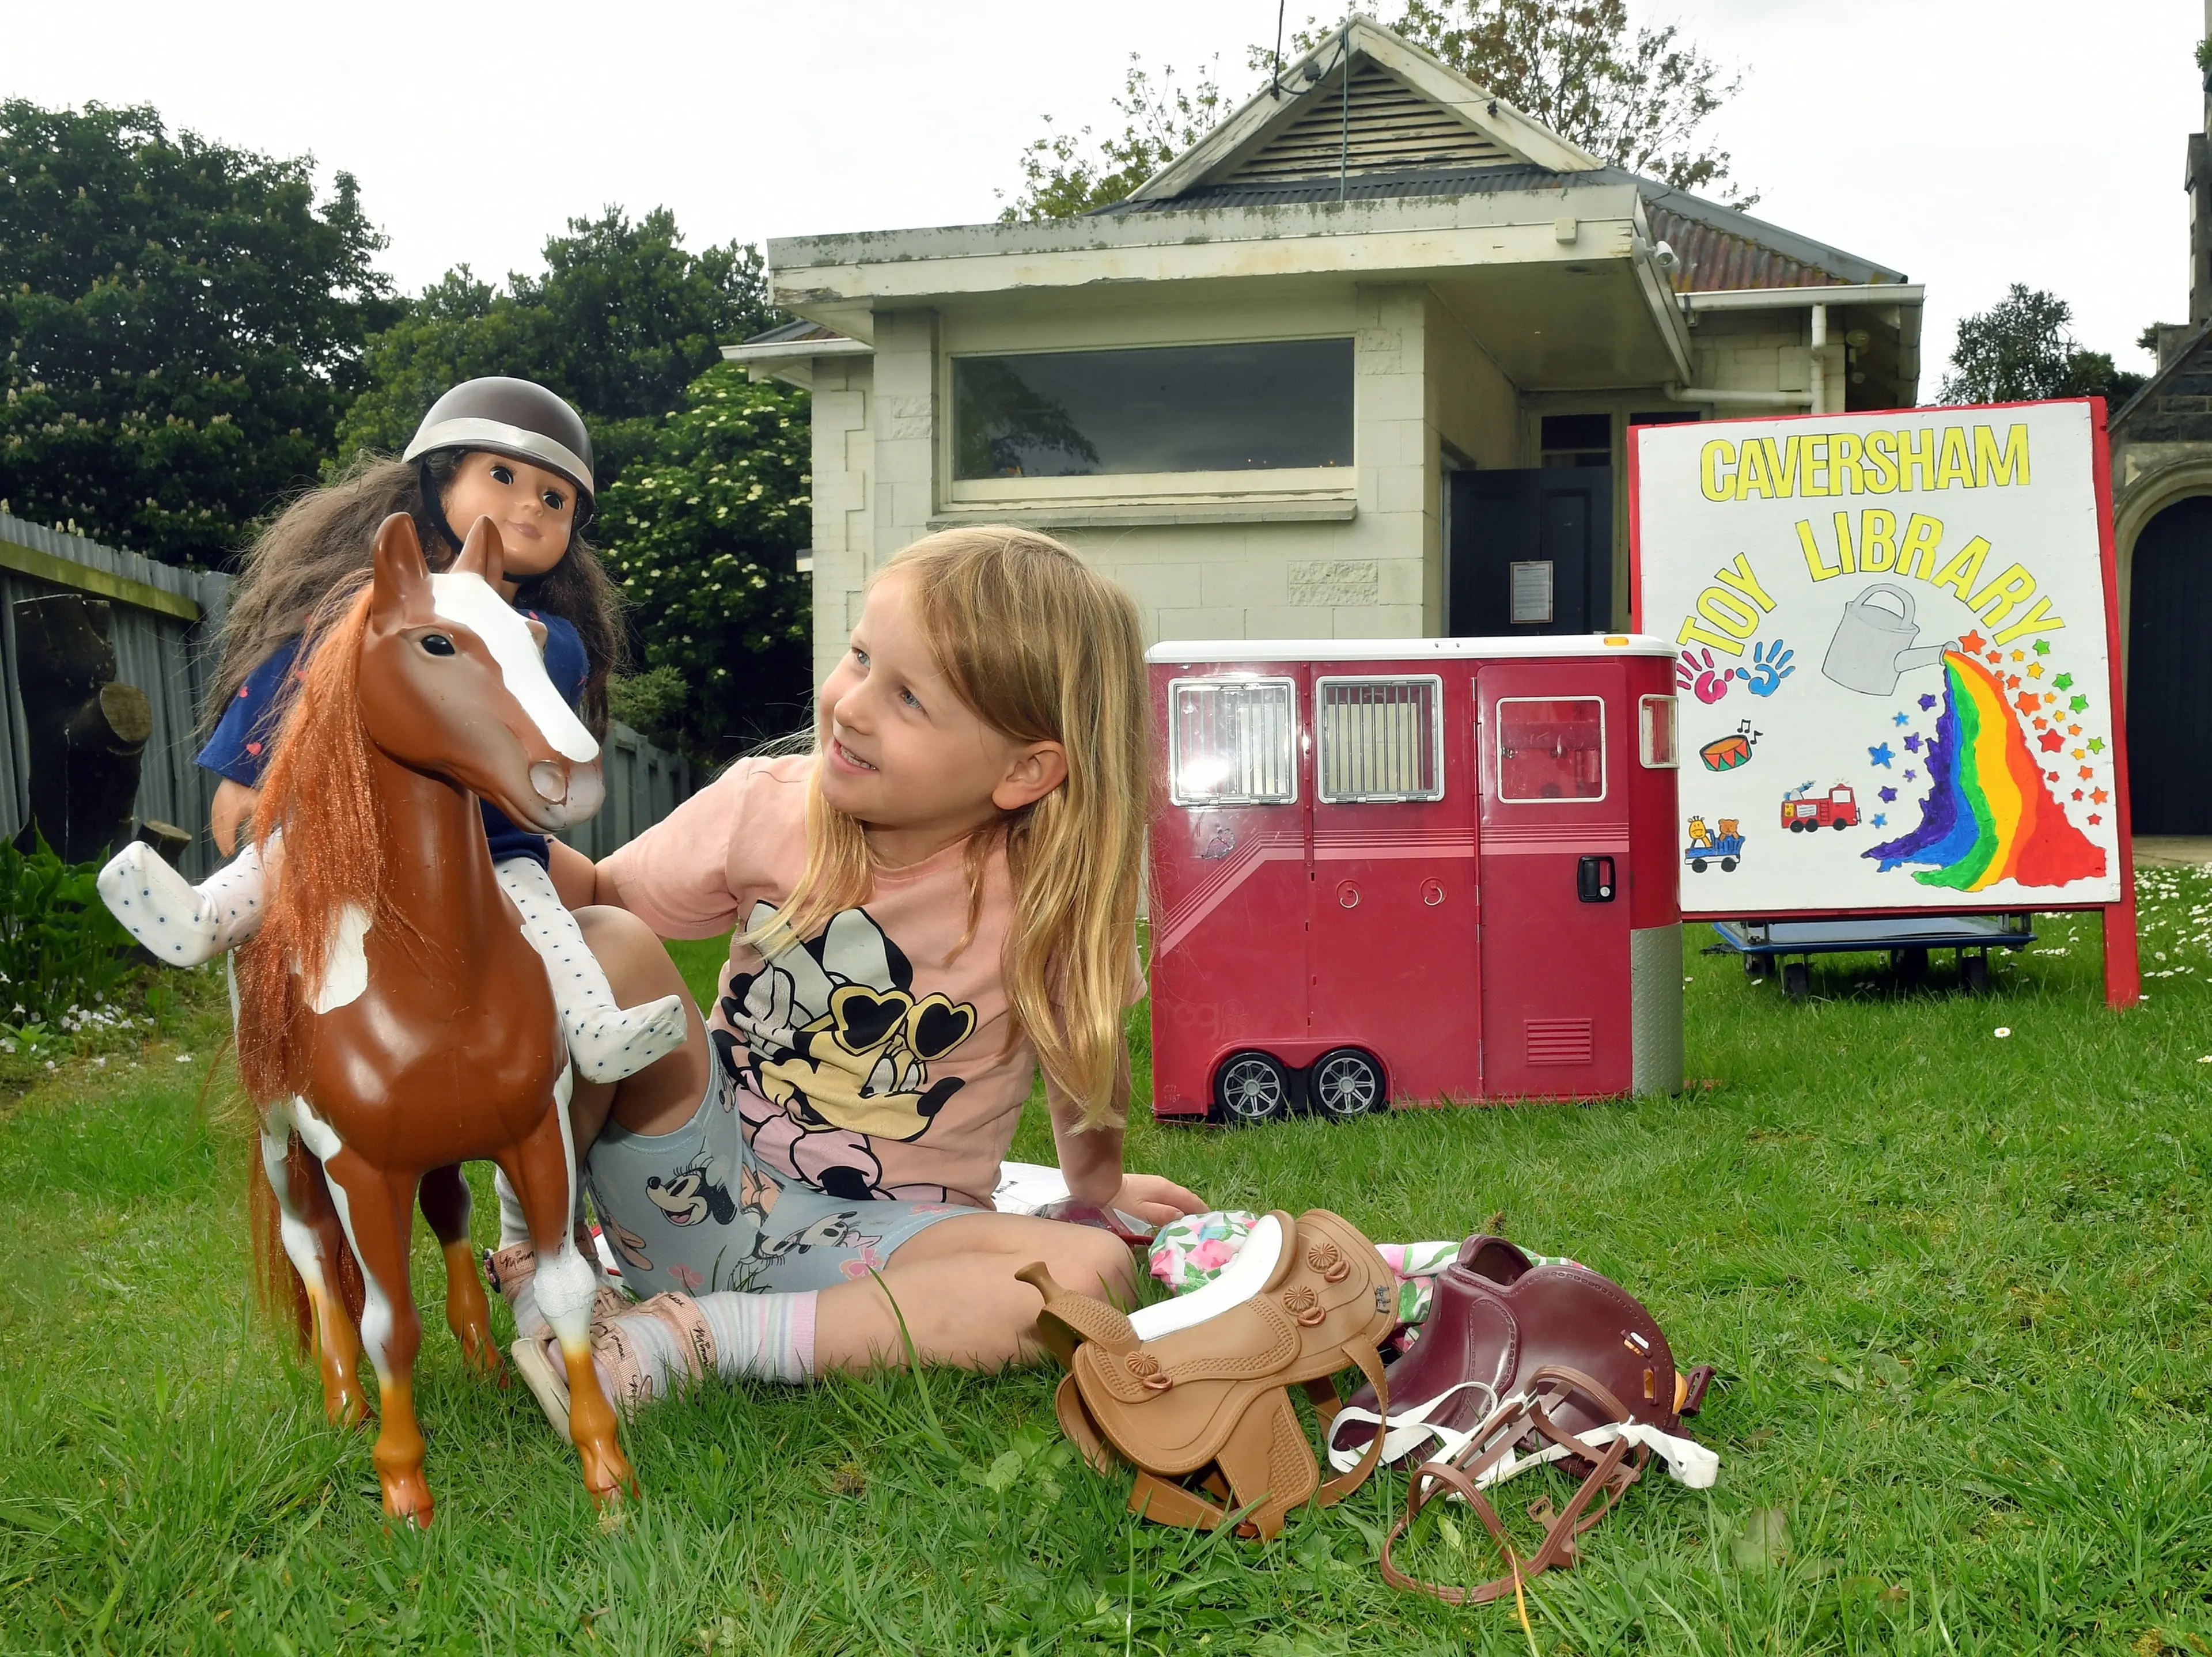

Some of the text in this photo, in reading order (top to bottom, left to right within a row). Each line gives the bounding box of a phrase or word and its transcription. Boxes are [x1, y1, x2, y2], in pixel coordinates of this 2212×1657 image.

[1701, 423, 2031, 502] CAVERSHAM
[1676, 509, 2065, 655] TOY LIBRARY
